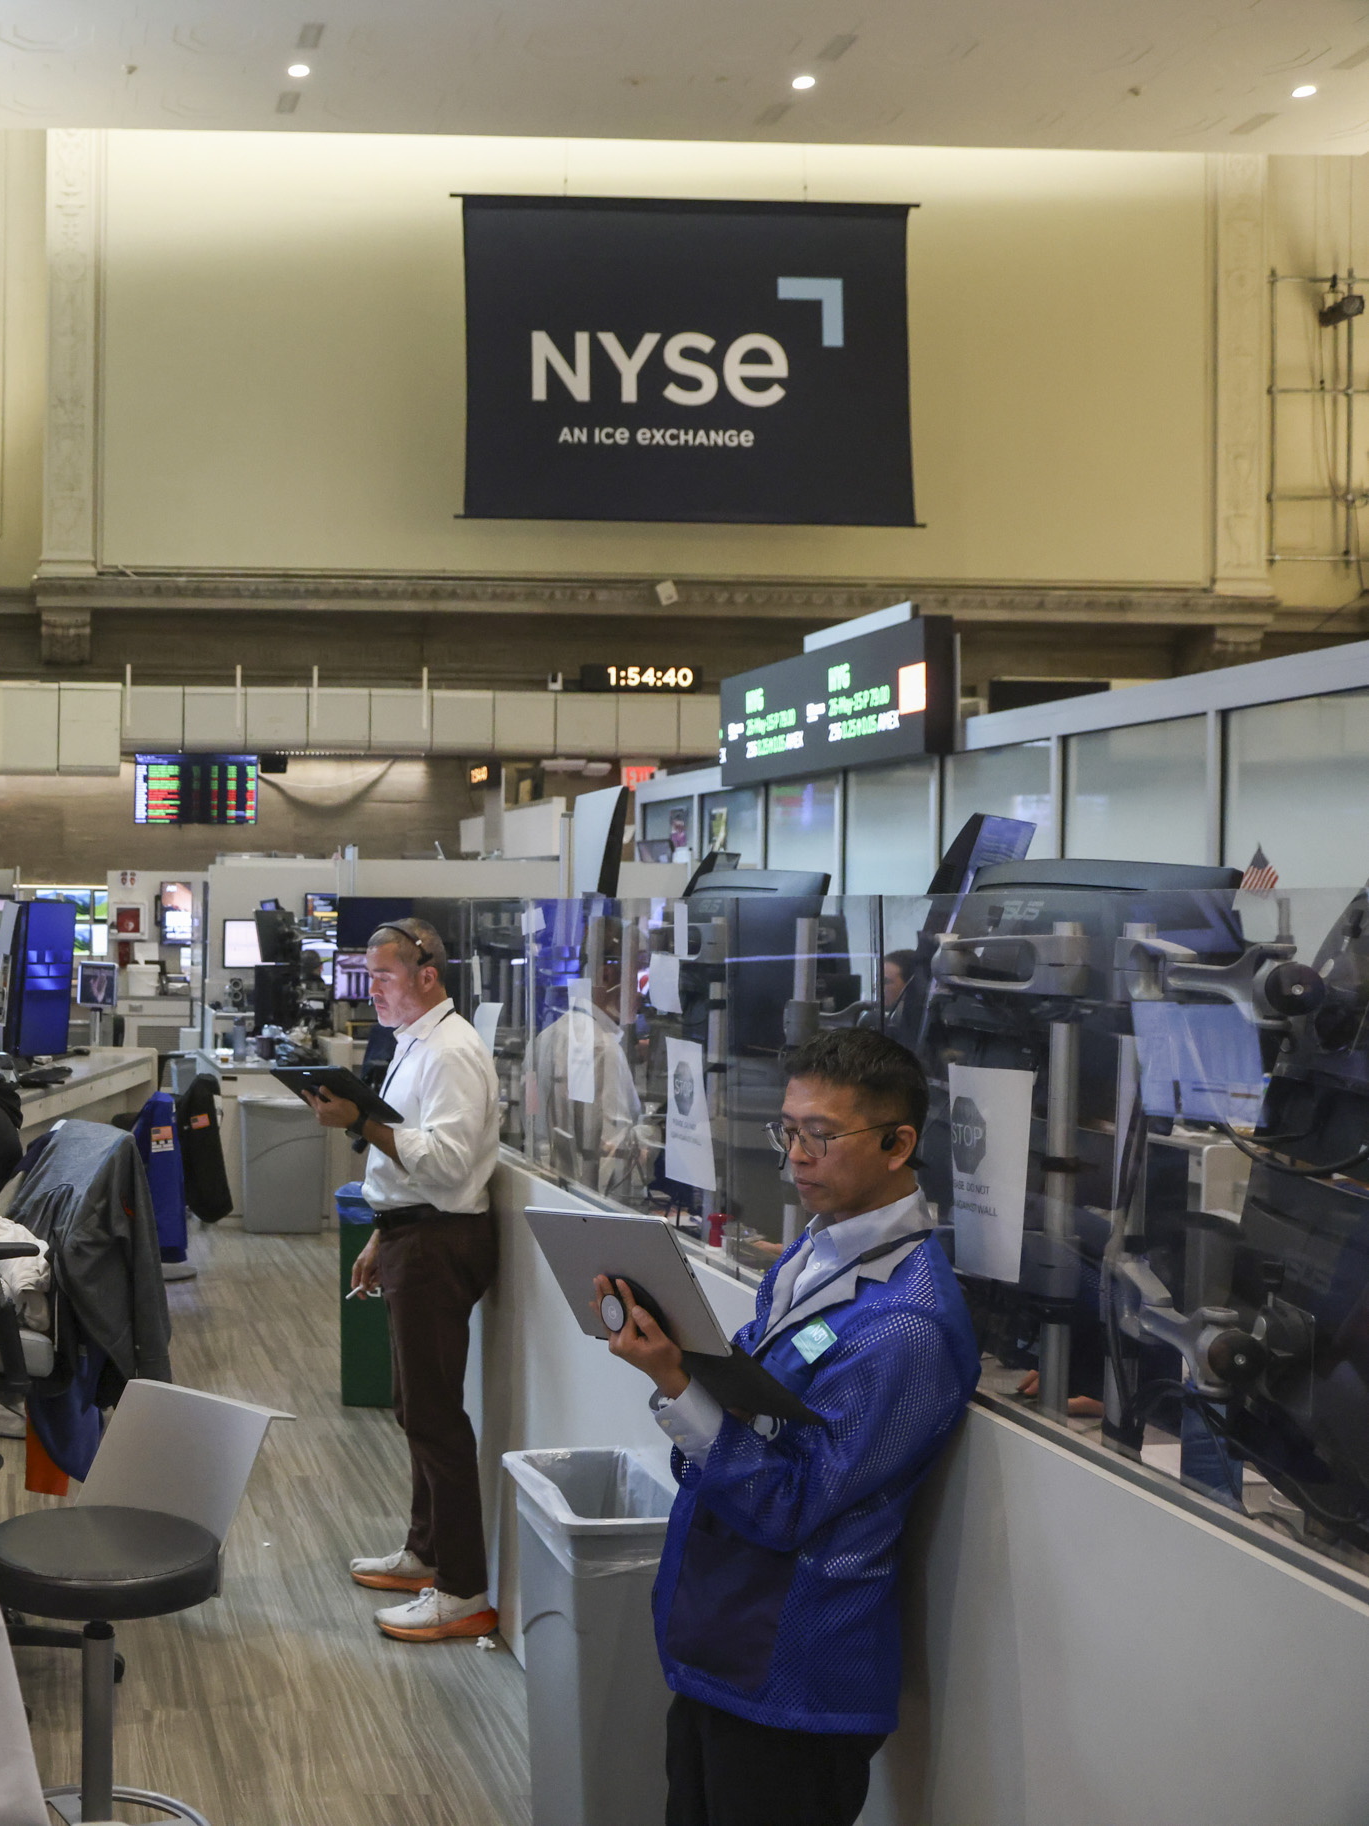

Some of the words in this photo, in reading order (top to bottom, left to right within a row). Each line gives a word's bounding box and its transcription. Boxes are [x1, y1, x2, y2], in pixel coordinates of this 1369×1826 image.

[558, 427, 587, 443] AN
[607, 666, 694, 687] 1:54:40
[952, 1122, 982, 1148] STOP
